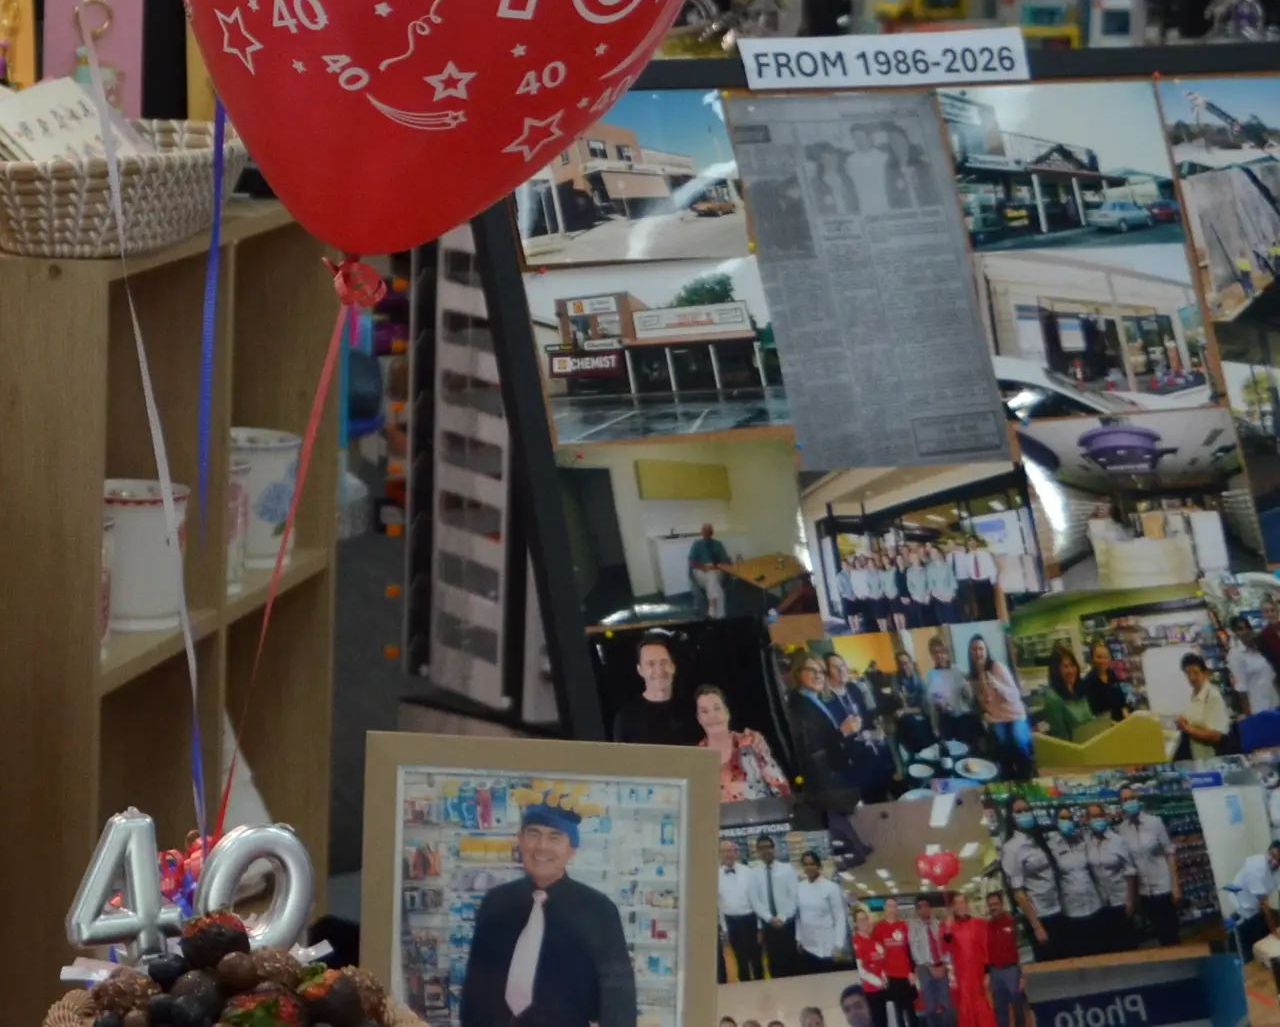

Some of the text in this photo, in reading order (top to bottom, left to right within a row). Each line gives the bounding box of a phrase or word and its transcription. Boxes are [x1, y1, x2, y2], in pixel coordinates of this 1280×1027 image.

[321, 54, 370, 91] 40
[515, 61, 567, 96] 40
[752, 46, 1016, 79] FROM 1986-2026
[570, 354, 617, 371] CHEMIST
[67, 808, 314, 968] 40
